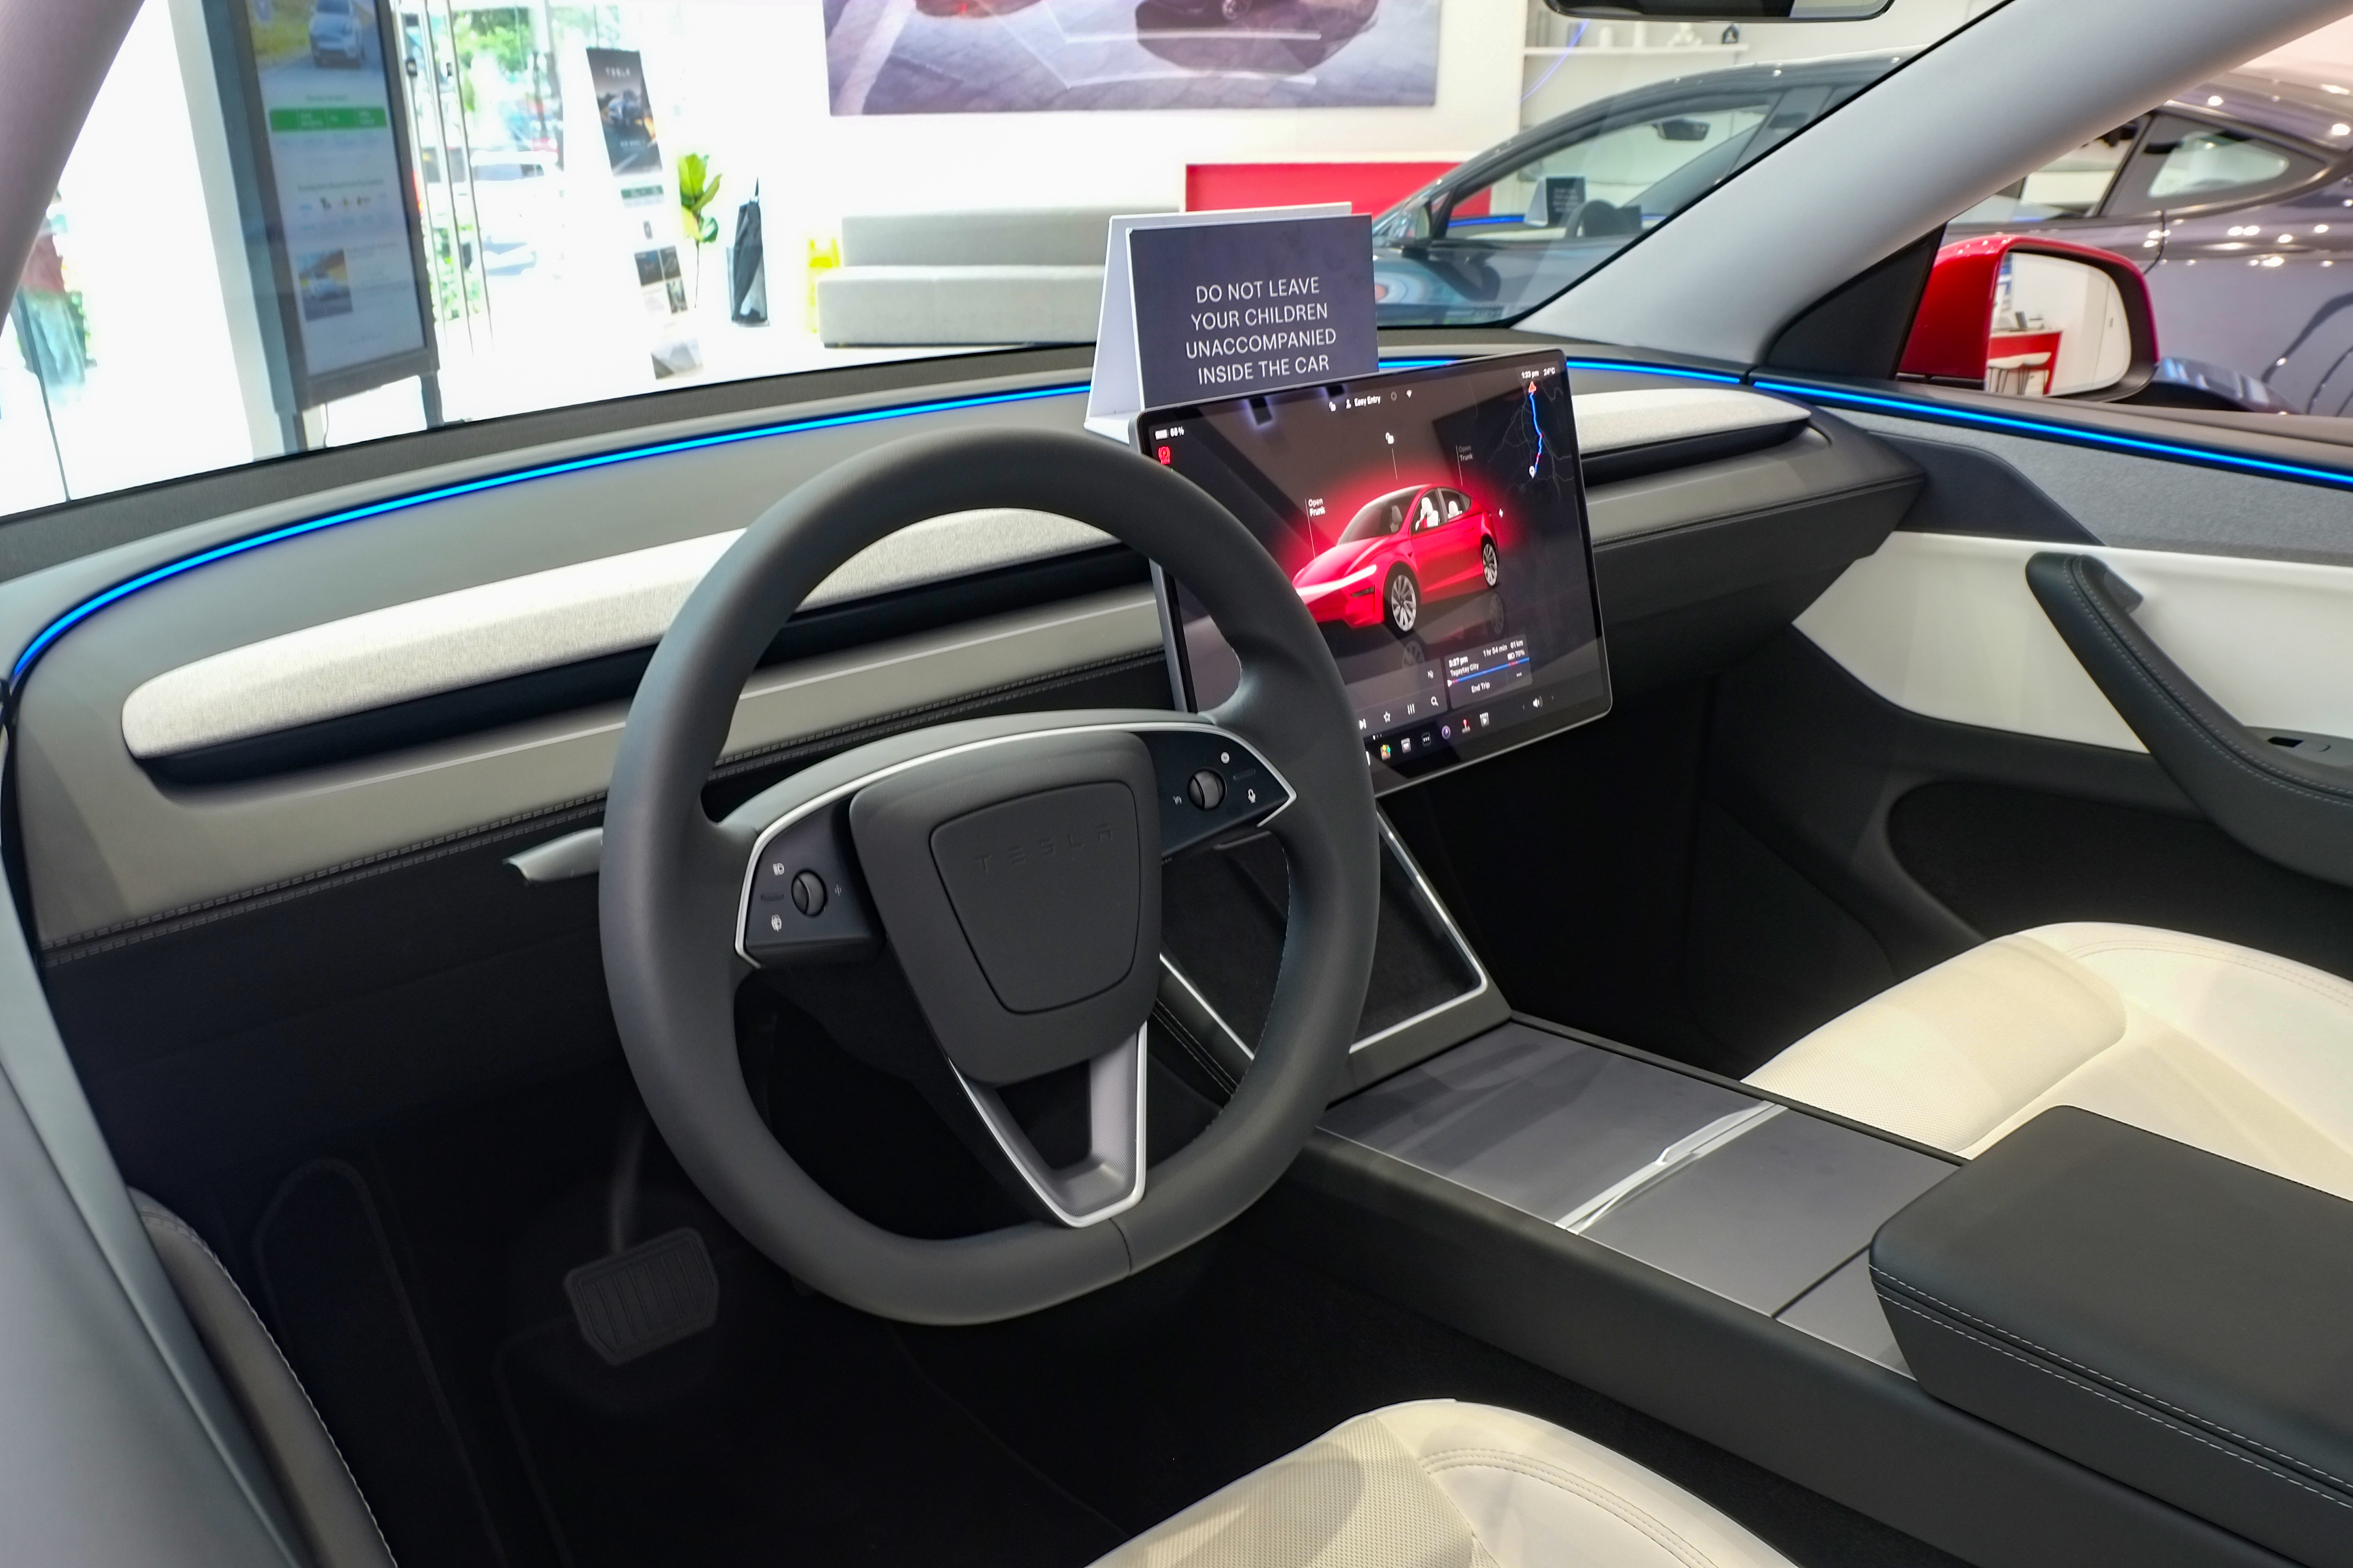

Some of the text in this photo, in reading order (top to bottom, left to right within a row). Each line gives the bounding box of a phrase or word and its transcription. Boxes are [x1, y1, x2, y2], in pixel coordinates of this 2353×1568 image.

[1196, 277, 1320, 304] DO NOT LEAVE
[1191, 303, 1327, 331] YOUR CHILDREN
[1186, 328, 1336, 359] UNACCOMPANIED
[1198, 355, 1329, 385] INSIDE THE CAR
[1367, 396, 1381, 405] Entry
[1459, 453, 1473, 461] Trunk
[1308, 498, 1323, 508] Open
[1498, 644, 1508, 652] min
[1460, 656, 1468, 666] pm
[1471, 681, 1490, 693] End Trip
[975, 823, 1112, 873] TESLA
